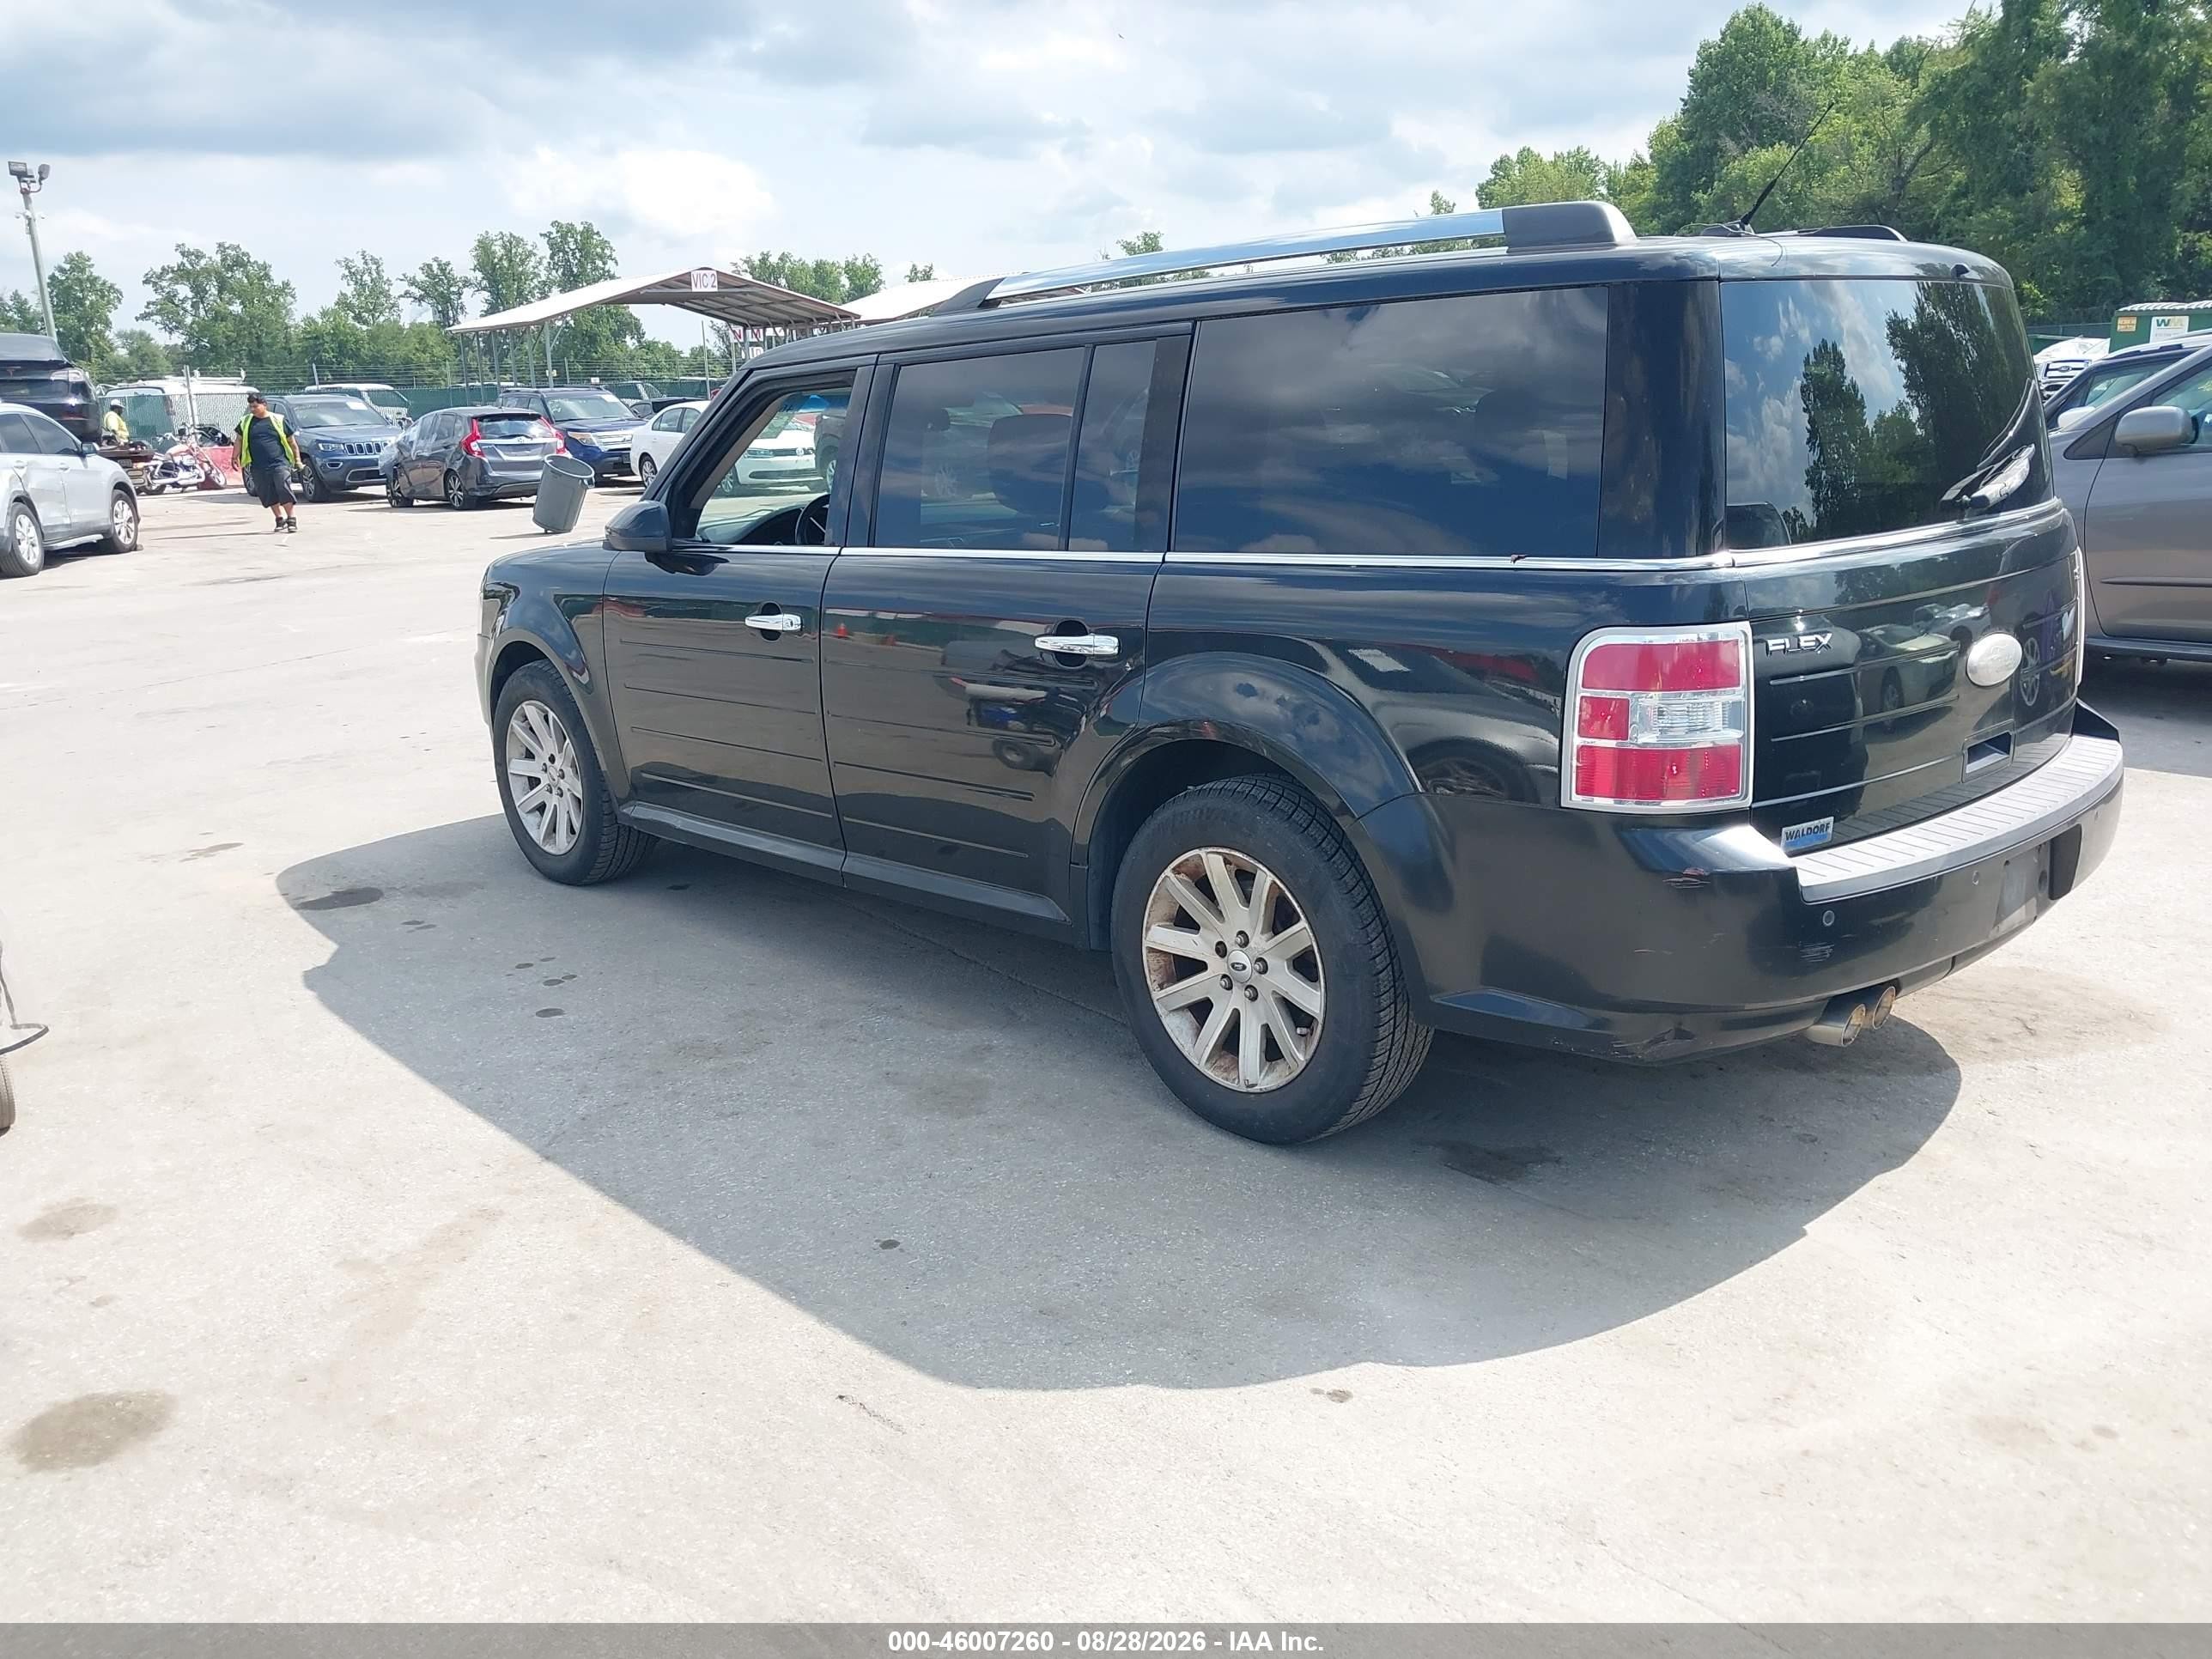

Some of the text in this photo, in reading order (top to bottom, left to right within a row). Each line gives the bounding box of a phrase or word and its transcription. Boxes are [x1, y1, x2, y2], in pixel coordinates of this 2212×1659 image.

[692, 273, 717, 289] VIC 2
[1766, 633, 1832, 655] FLEX
[1785, 823, 1831, 842] WALDORF
